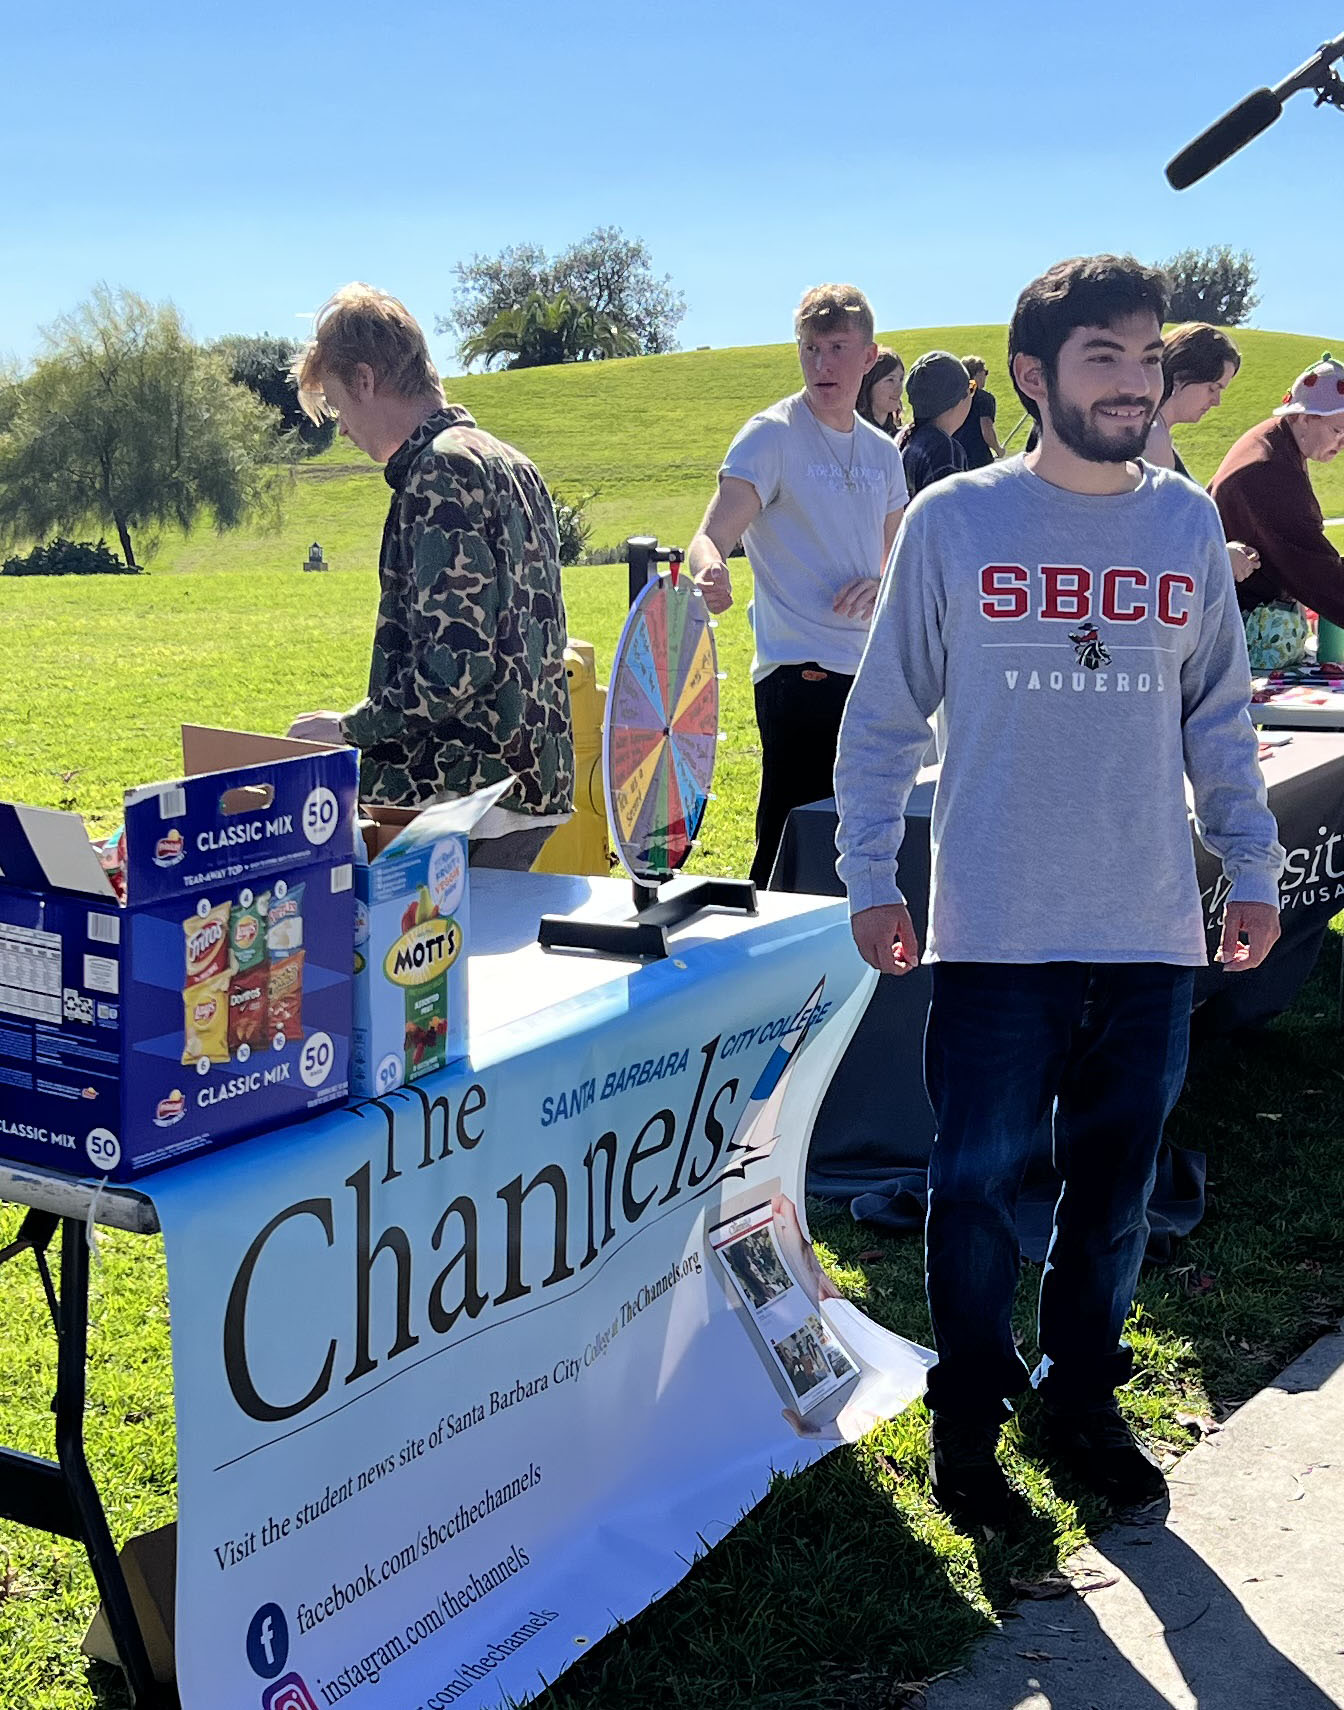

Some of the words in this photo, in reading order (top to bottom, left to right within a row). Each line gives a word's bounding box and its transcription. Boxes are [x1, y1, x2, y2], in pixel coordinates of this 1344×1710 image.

[978, 562, 1195, 629] SBCC
[1005, 671, 1164, 692] VAQUEROS
[197, 822, 262, 852] CLASSIC
[265, 814, 294, 839] MIX
[308, 799, 334, 827] 50
[189, 922, 223, 962] Fritos
[305, 1043, 329, 1071] 50
[381, 1062, 397, 1085] 90
[541, 1077, 597, 1127] SANTA
[600, 1048, 690, 1101] BARBARA
[720, 1028, 760, 1060] CITY
[757, 1001, 833, 1045] COLLEGE
[197, 1072, 260, 1108] CLASSIC
[264, 1062, 291, 1086] MIX
[51, 1132, 76, 1149] MIX
[91, 1136, 116, 1157] 50
[344, 1084, 487, 1184] The
[223, 1033, 739, 1422] Channels
[214, 1532, 257, 1572] Visit
[261, 1516, 291, 1547] the
[295, 1476, 354, 1530] student
[357, 1454, 396, 1493] news
[399, 1438, 425, 1467] site
[428, 1417, 445, 1450] of
[446, 1402, 485, 1440] Santa
[489, 1374, 549, 1417] Barbara
[553, 1356, 583, 1383] City
[582, 1327, 612, 1367] College
[619, 1251, 703, 1329] TheChannels.org
[296, 1462, 542, 1636] facebook.com/sbccthechannels
[317, 1544, 531, 1707] instagram.com/thechannels
[416, 1608, 559, 1710] com/thechannels
